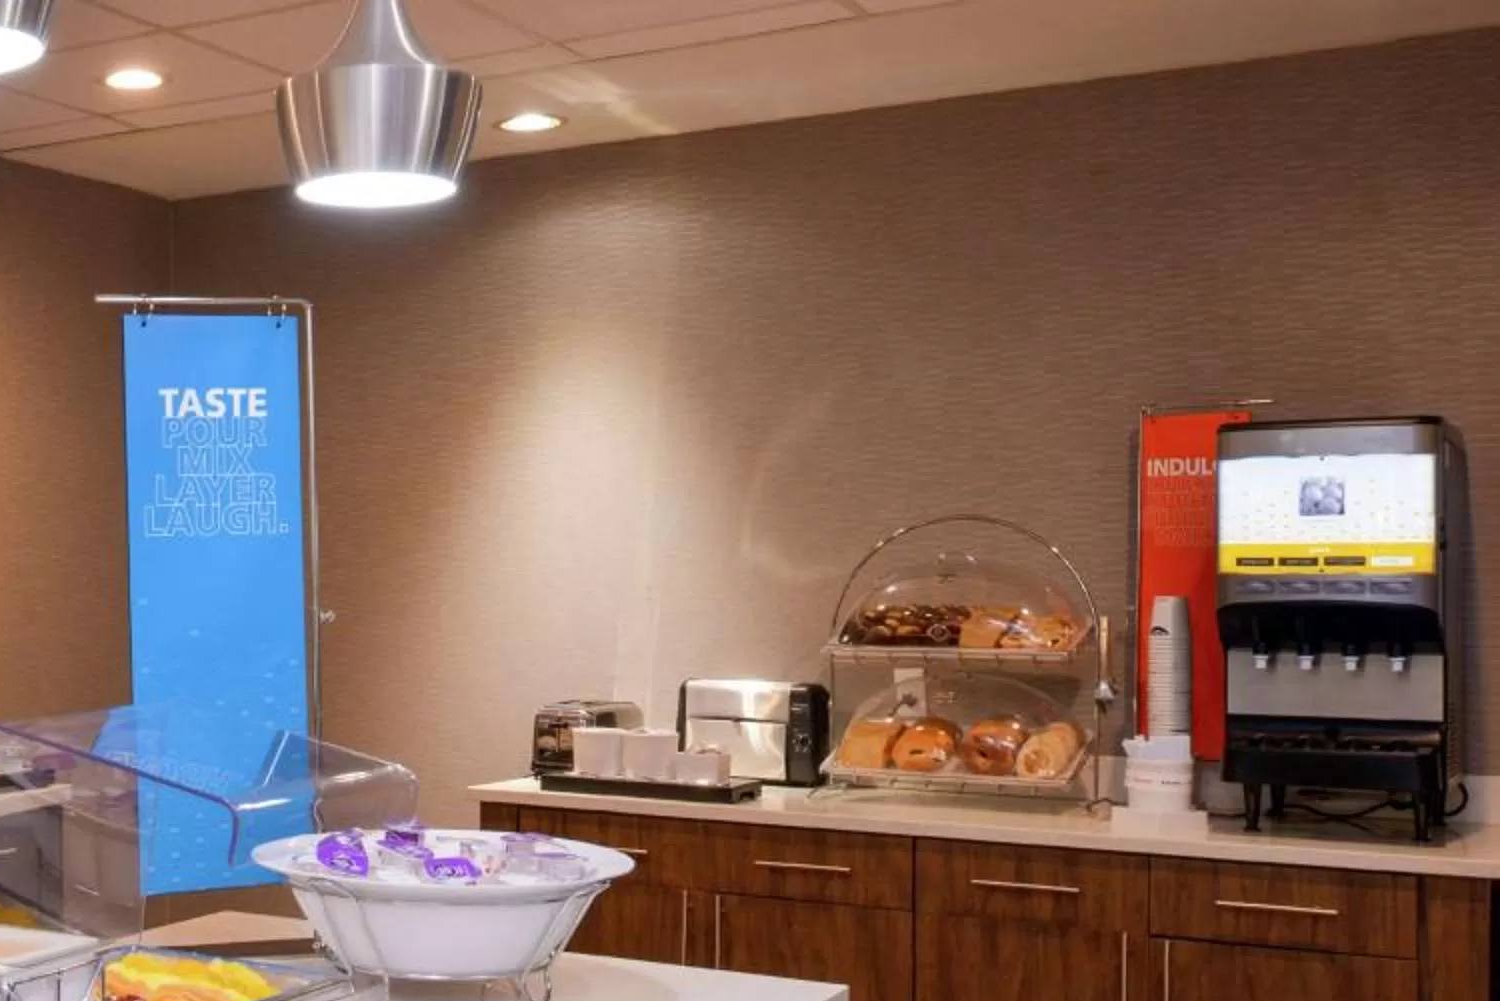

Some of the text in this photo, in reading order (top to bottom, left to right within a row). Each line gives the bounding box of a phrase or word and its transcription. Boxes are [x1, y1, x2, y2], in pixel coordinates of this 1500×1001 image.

[158, 387, 269, 418] TASTE
[163, 416, 268, 448] POUR
[177, 445, 255, 477] MIX
[1147, 456, 1217, 477] INDUL
[155, 474, 277, 506] LAYER
[144, 502, 289, 538] LAUGH.
